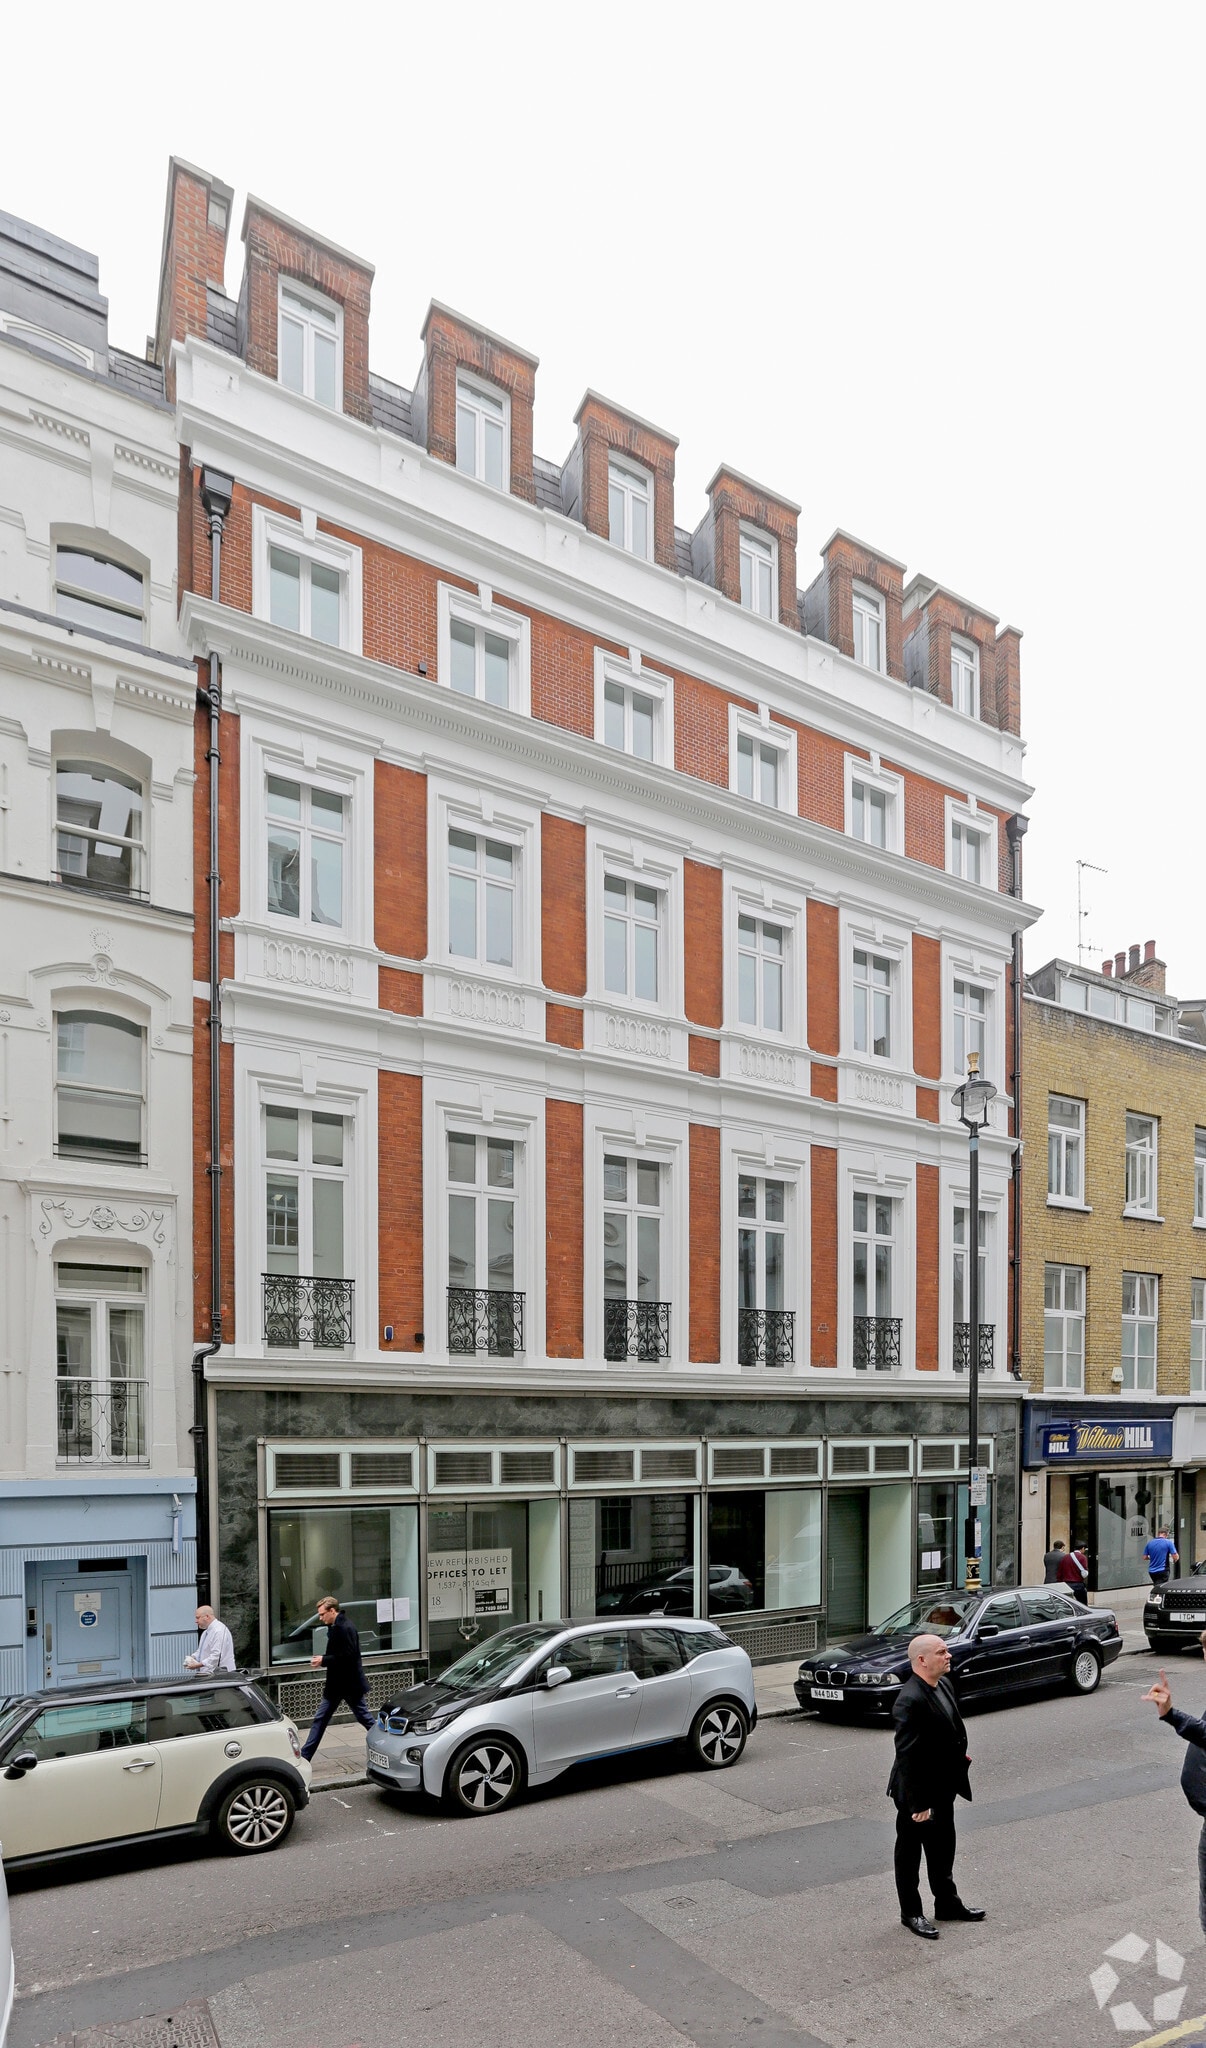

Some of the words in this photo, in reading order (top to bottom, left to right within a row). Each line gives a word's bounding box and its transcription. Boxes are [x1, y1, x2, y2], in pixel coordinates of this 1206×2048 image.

[1074, 1424, 1124, 1449] William
[1124, 1427, 1153, 1448] HILL
[1048, 1442, 1069, 1453] HILL
[1131, 1528, 1143, 1536] HILL
[446, 1556, 508, 1566] REFURBISHED
[472, 1568, 485, 1576] TO
[490, 1567, 507, 1575] LET
[438, 1581, 456, 1590] 1,537
[432, 1596, 441, 1606] 18
